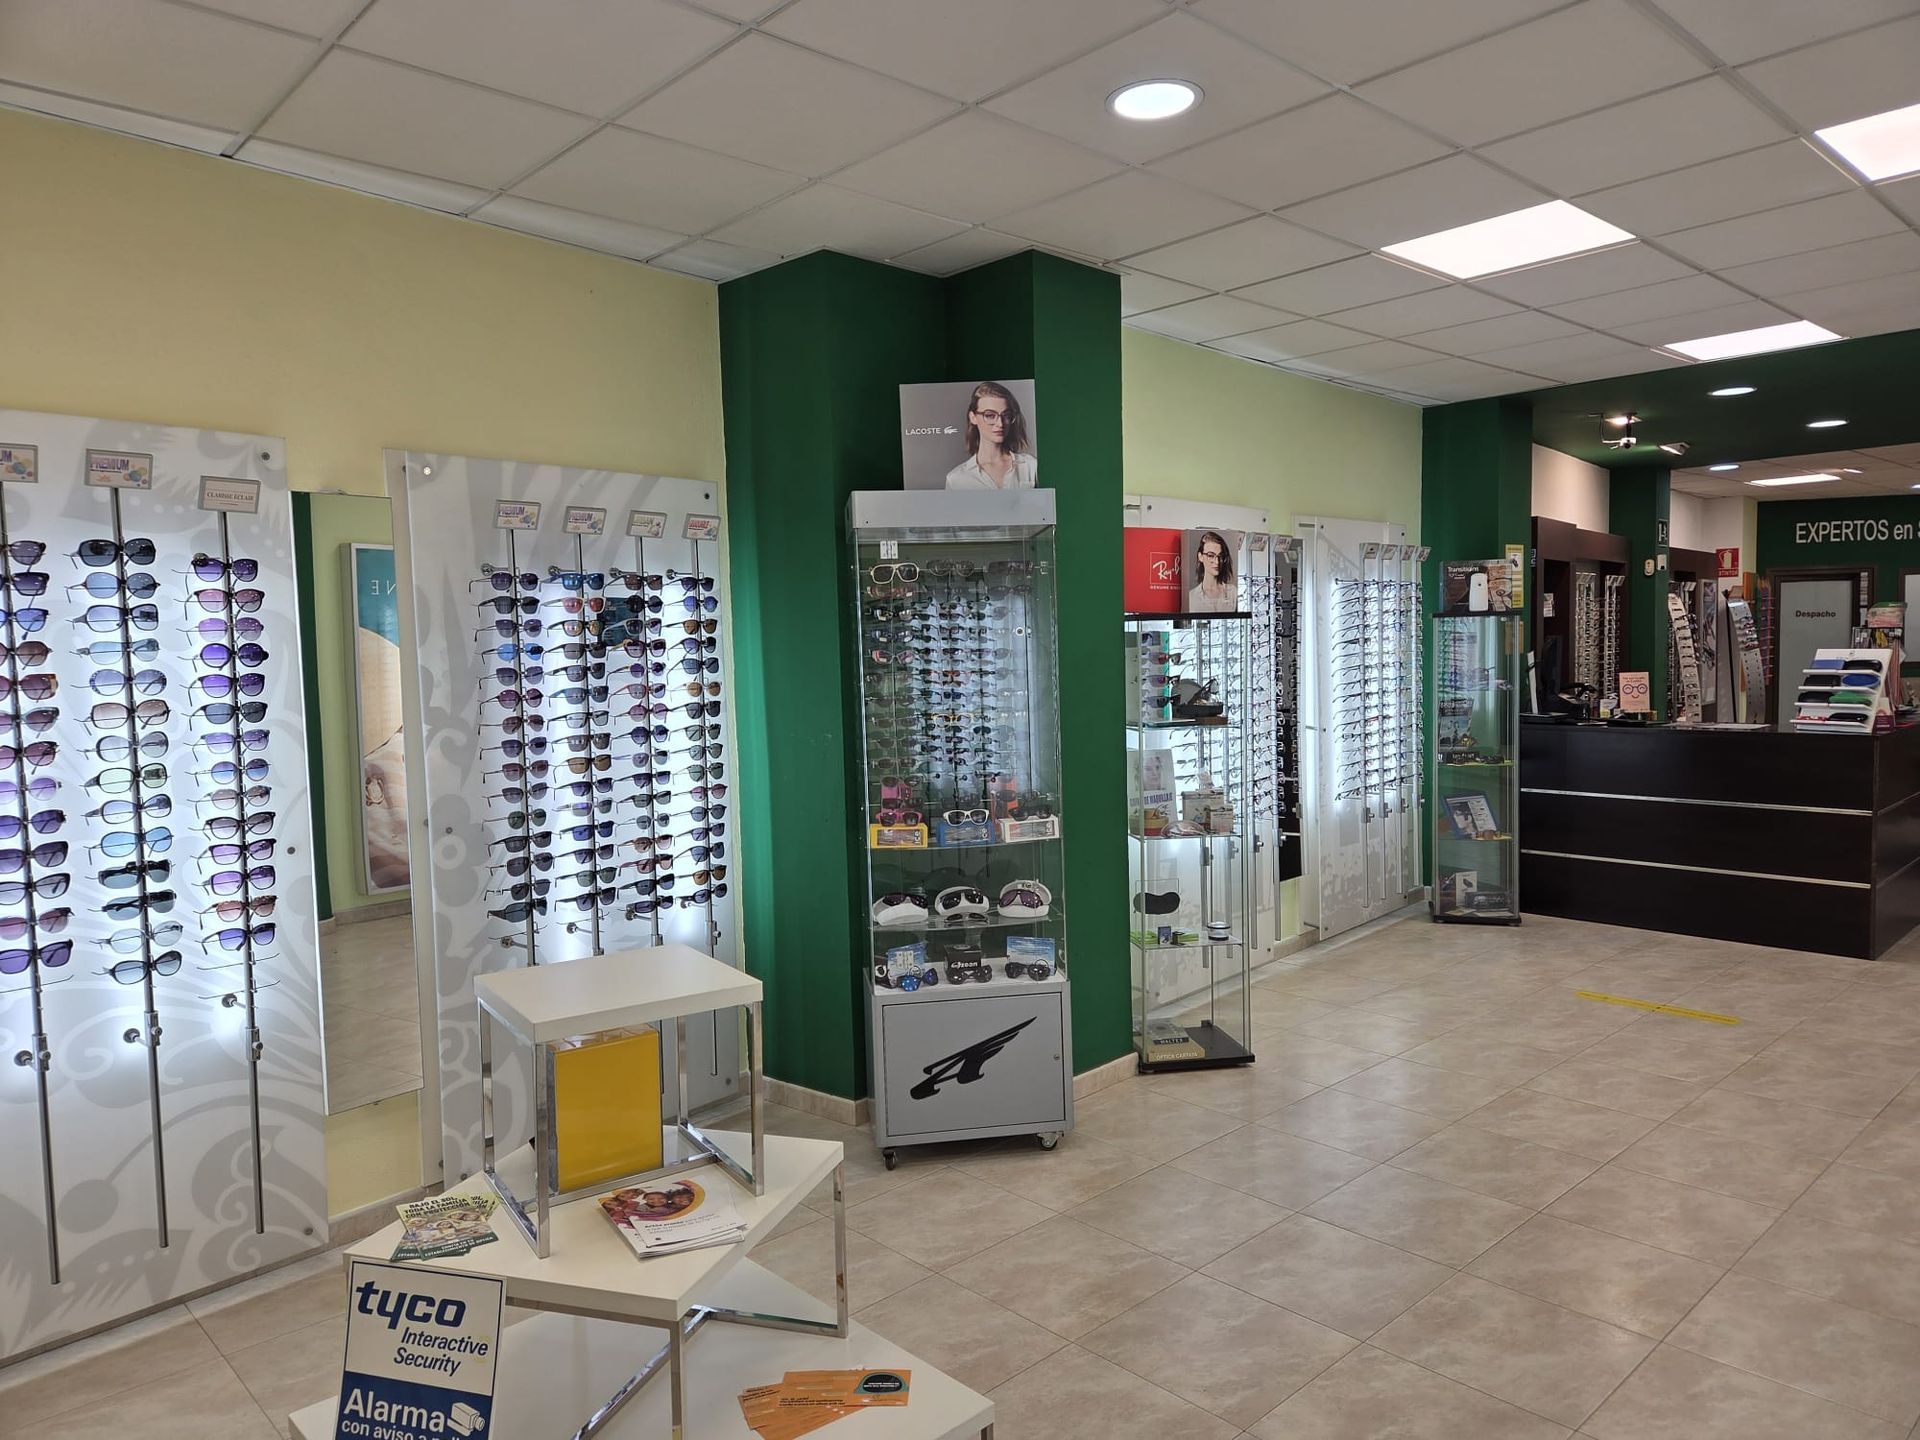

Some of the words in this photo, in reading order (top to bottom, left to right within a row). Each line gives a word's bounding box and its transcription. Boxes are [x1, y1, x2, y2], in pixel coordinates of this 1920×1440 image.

[905, 427, 941, 435] LACOSTE
[1795, 519, 1889, 543] EXPERTOS
[1893, 523, 1913, 540] en
[1152, 555, 1180, 581] Ray-B
[1795, 610, 1836, 618] Despacho
[437, 1198, 468, 1208] FAMILIA
[356, 1281, 466, 1330] tyco
[401, 1326, 488, 1356] Interactive
[394, 1347, 461, 1377] Security
[343, 1388, 445, 1433] Alarma
[341, 1420, 370, 1436] con
